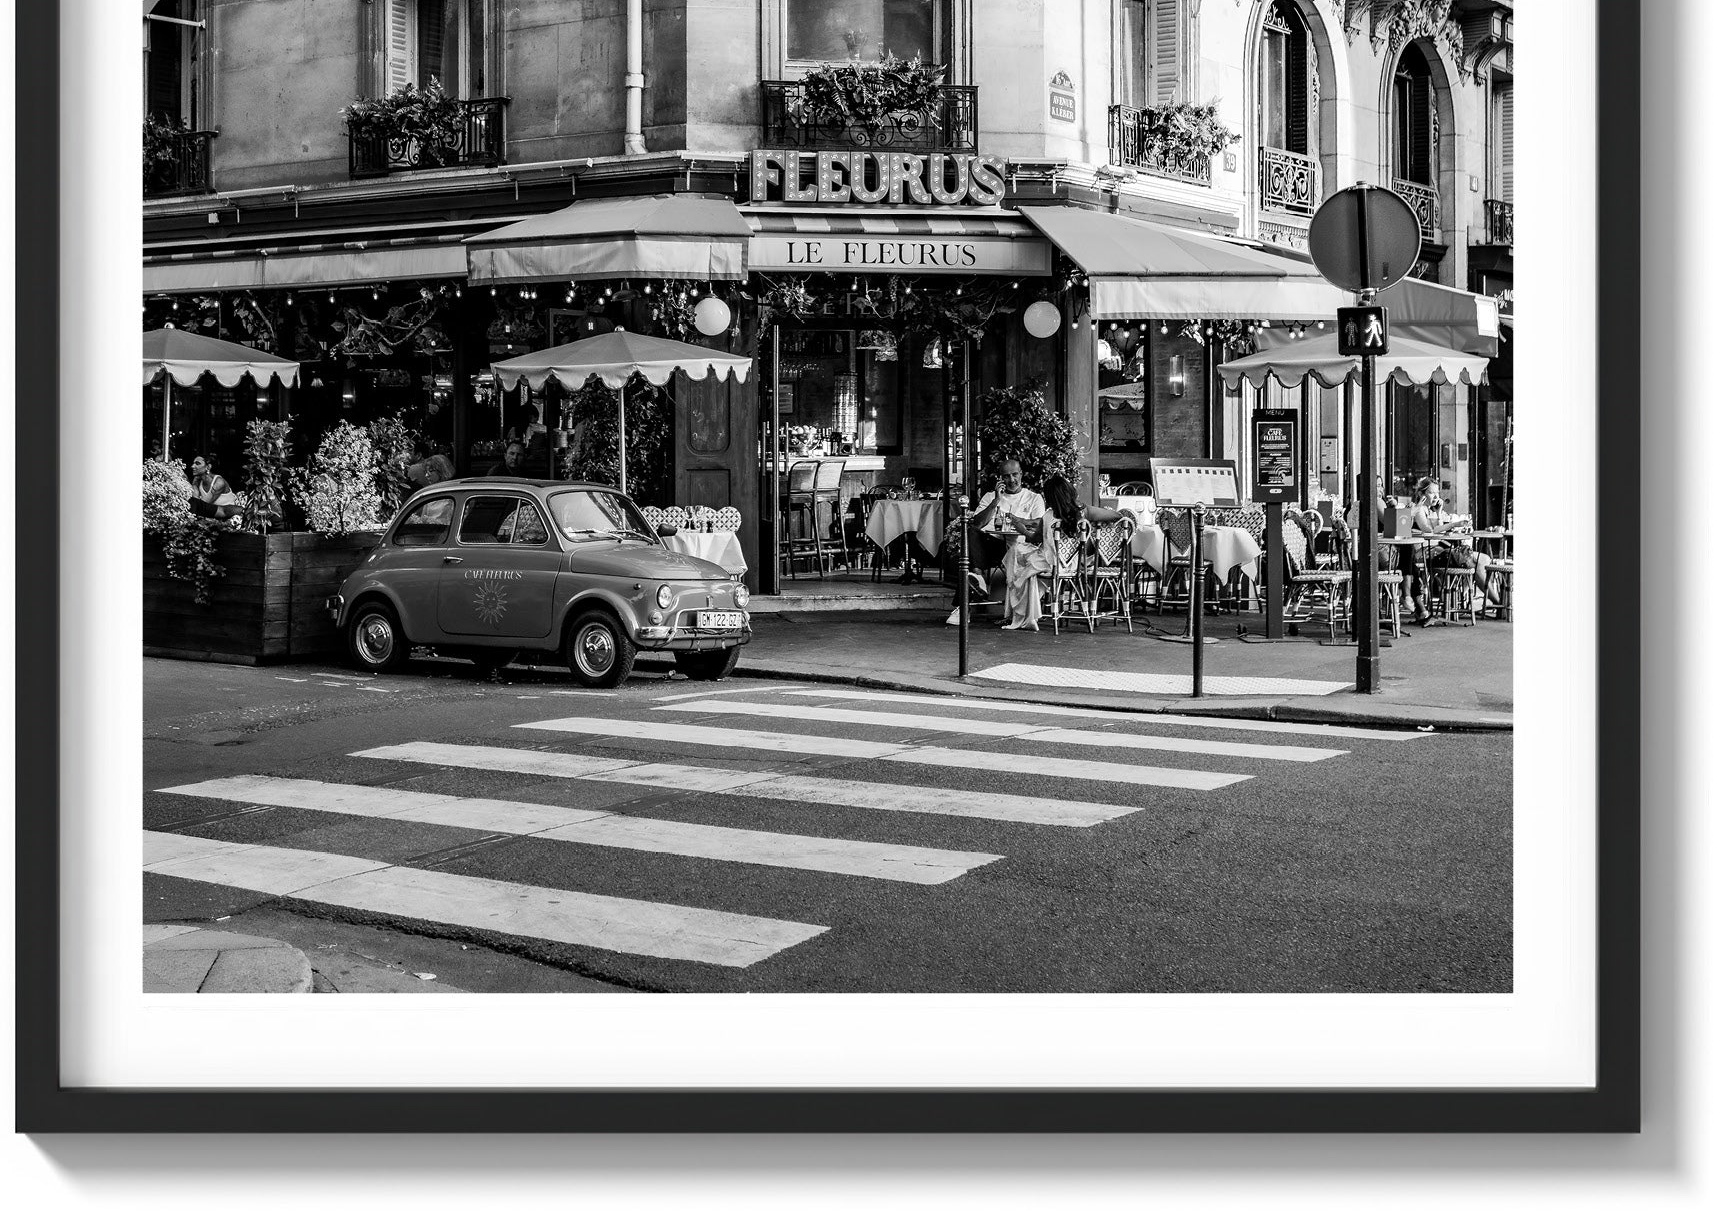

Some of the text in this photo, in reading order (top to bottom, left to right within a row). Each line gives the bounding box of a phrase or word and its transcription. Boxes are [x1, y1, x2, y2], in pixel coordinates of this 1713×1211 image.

[1052, 95, 1073, 108] AVENUE
[1052, 106, 1074, 120] KLÉBER
[1226, 154, 1236, 170] 39
[752, 149, 1006, 205] FLEURUS
[786, 241, 977, 266] LE FLEURUS
[486, 570, 522, 580] FLEURUS
